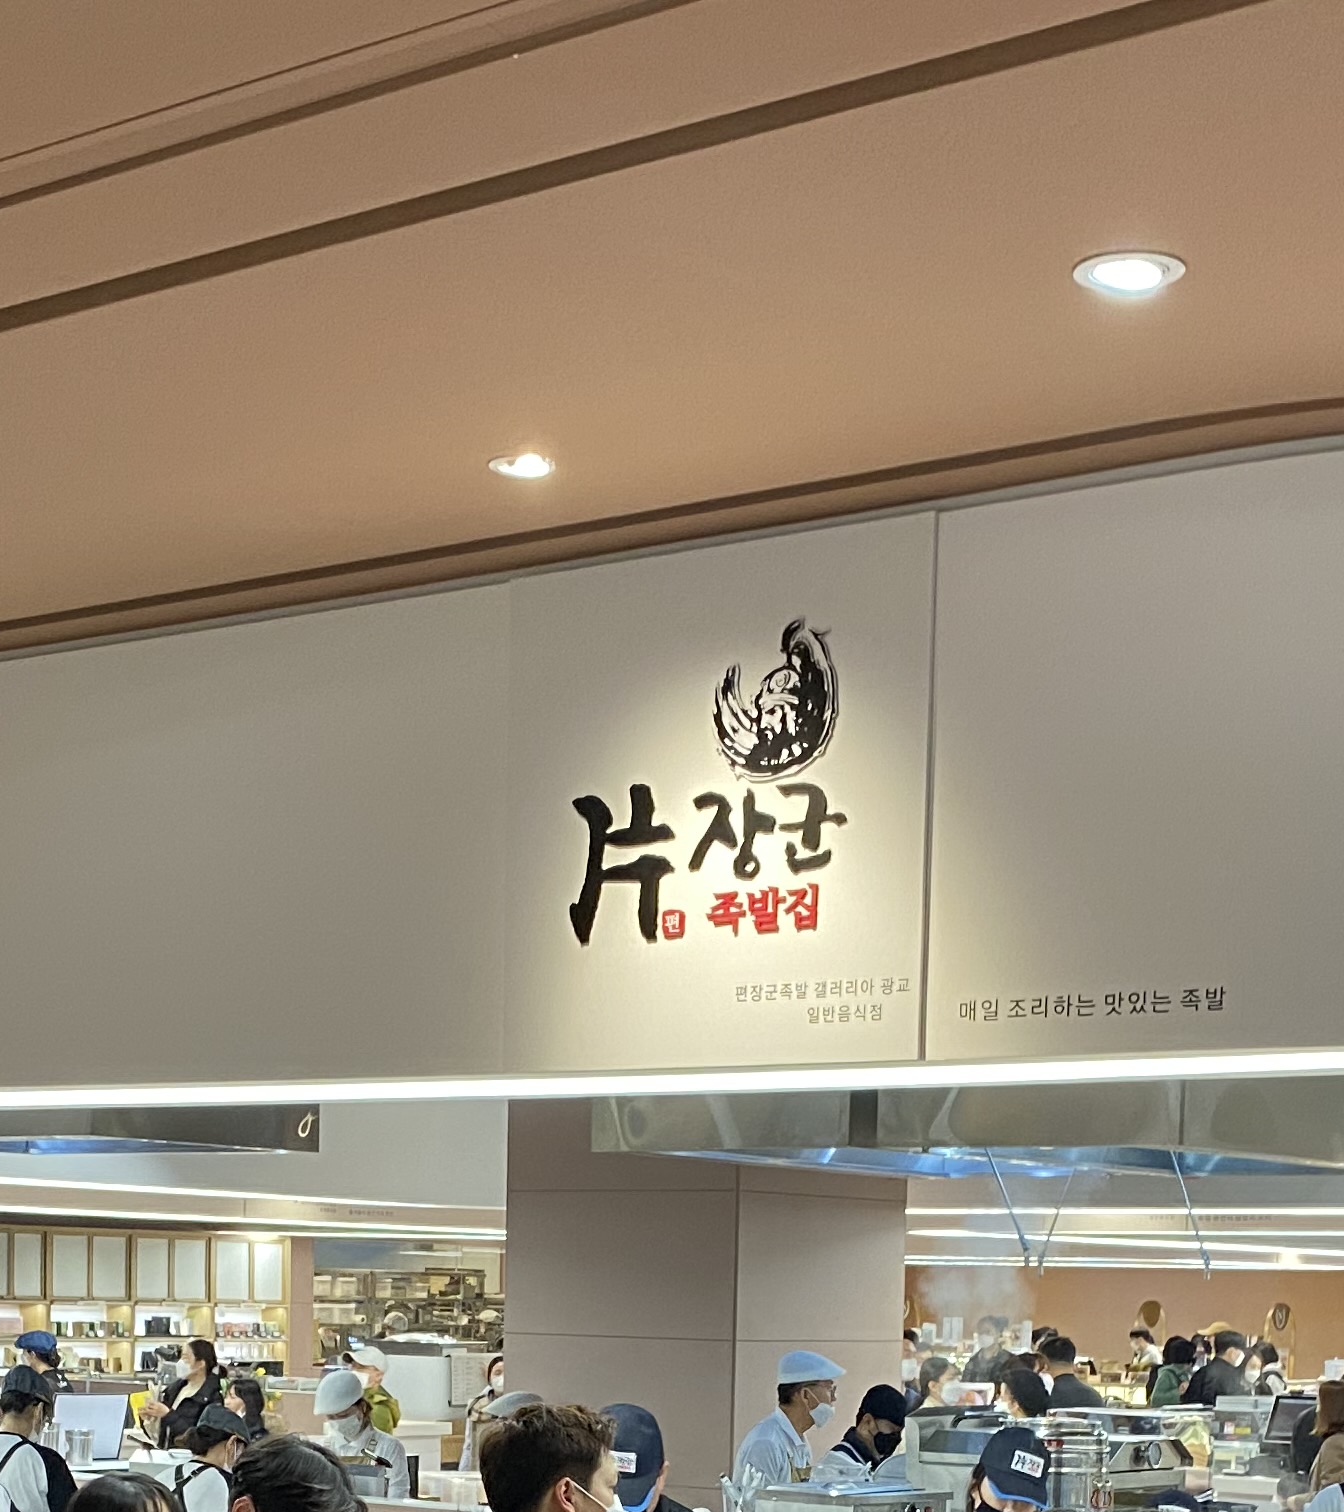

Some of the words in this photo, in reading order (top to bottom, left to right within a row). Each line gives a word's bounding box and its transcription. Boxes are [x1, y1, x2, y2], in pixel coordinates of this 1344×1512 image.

[688, 782, 848, 881] 장군
[663, 911, 683, 936] 편
[706, 883, 819, 937] 족발집
[735, 981, 808, 1003] 편장군족발
[814, 978, 875, 999] 갤러리아
[880, 977, 911, 996] 광교
[958, 998, 999, 1022] 매일
[1007, 994, 1096, 1019] 조리하는
[1104, 990, 1172, 1017] 맛있는
[1180, 985, 1226, 1013] 족발
[807, 1003, 883, 1025] 일반음식점
